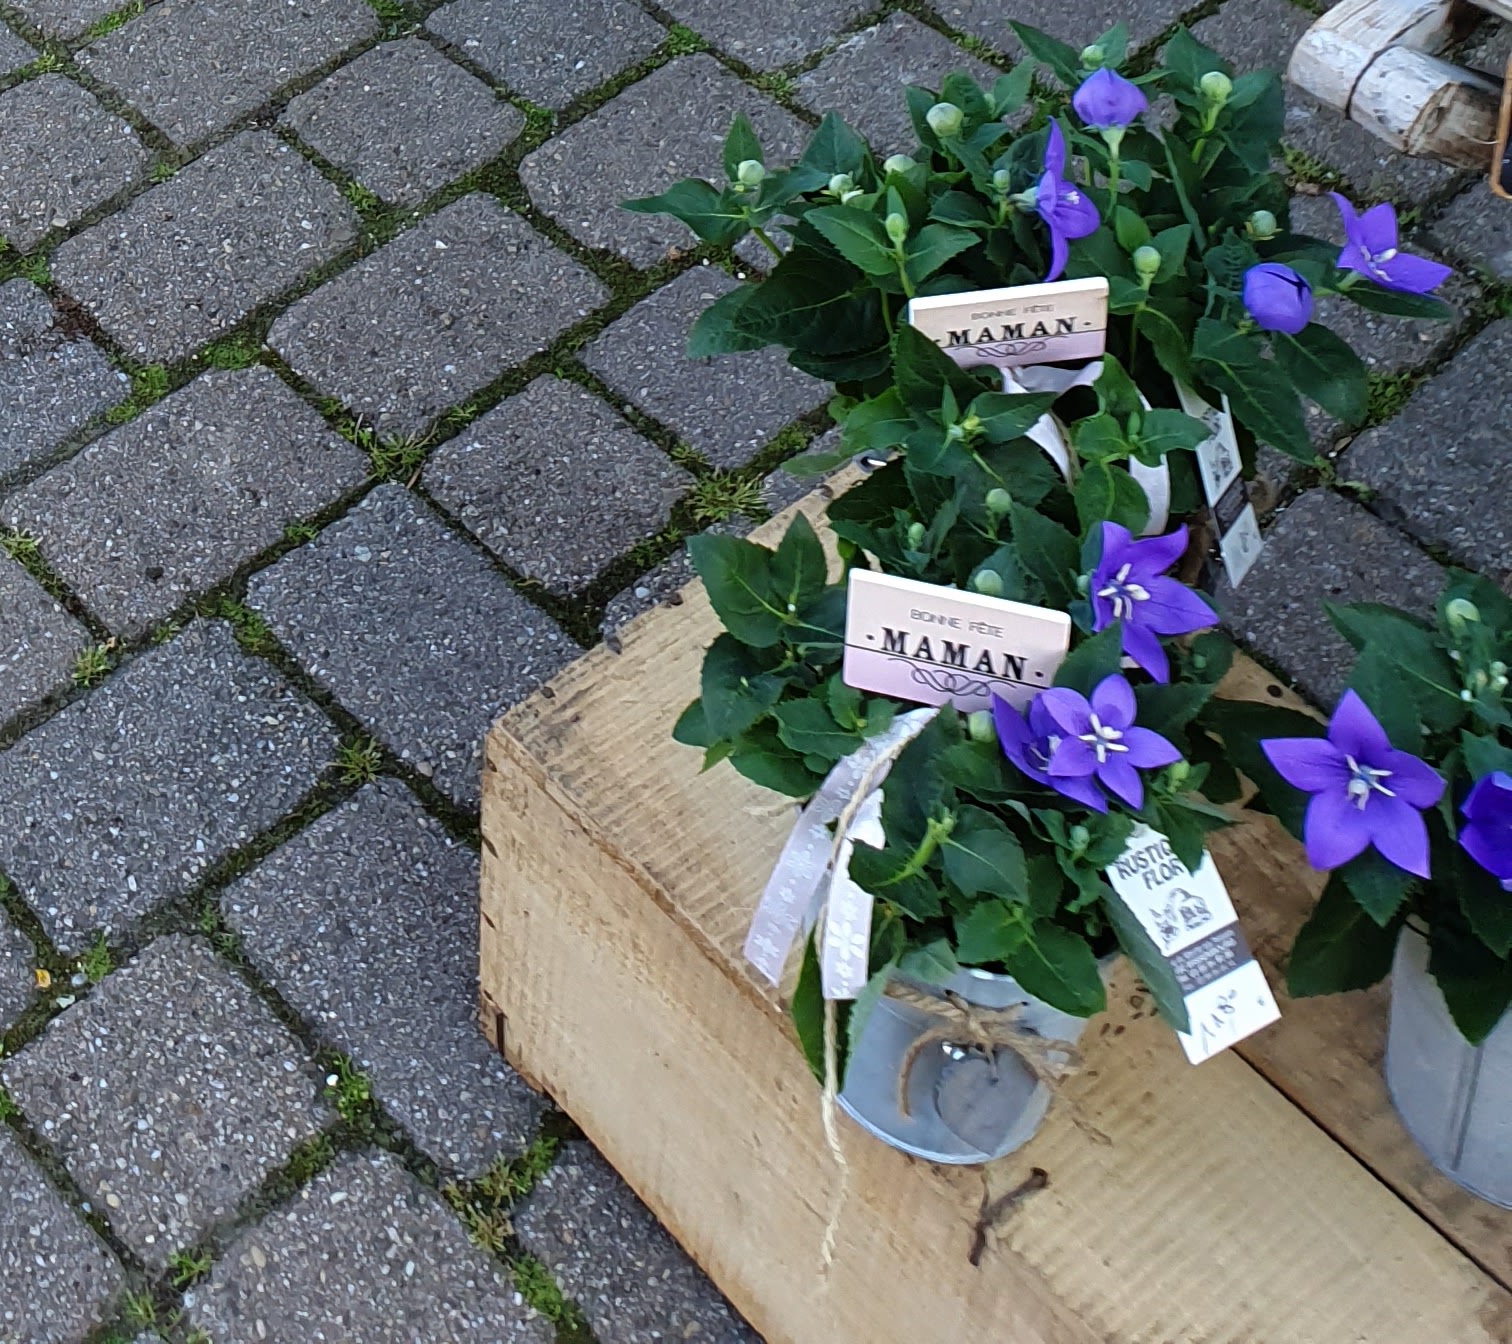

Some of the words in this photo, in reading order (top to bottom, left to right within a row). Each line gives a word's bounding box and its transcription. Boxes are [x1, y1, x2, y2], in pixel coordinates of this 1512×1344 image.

[970, 308, 1017, 321] BONNE
[946, 316, 1078, 347] MAMAN
[909, 608, 963, 630] BONNE
[968, 620, 1005, 639] FÊTE
[880, 626, 1029, 681] MAMAN
